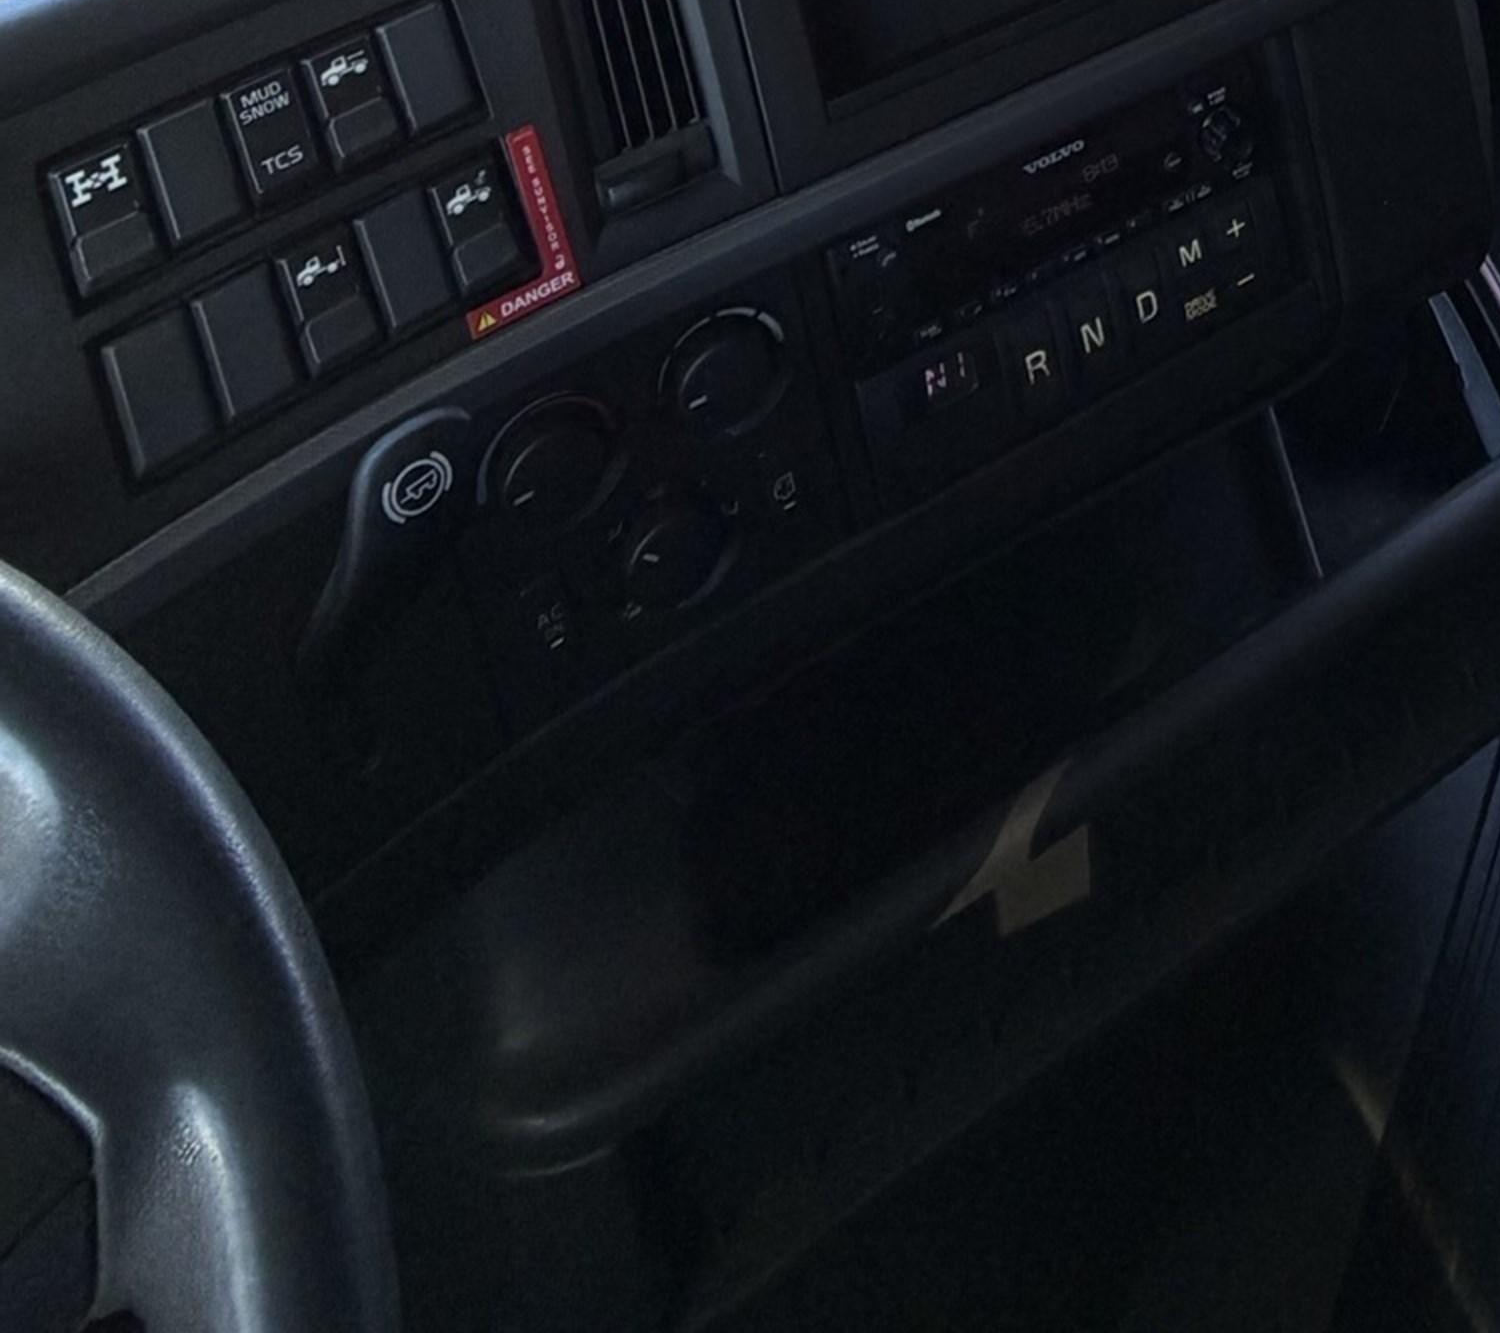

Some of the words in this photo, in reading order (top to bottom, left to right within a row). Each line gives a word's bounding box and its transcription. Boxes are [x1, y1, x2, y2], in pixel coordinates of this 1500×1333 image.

[239, 91, 290, 126] SNOW
[240, 81, 282, 109] MUD
[261, 144, 304, 175] TCS
[1023, 139, 1085, 174] VOLVO
[1178, 237, 1202, 268] M
[500, 271, 575, 318] DANGER
[1135, 290, 1159, 324] D
[1079, 316, 1106, 354] N
[1024, 349, 1051, 384] R
